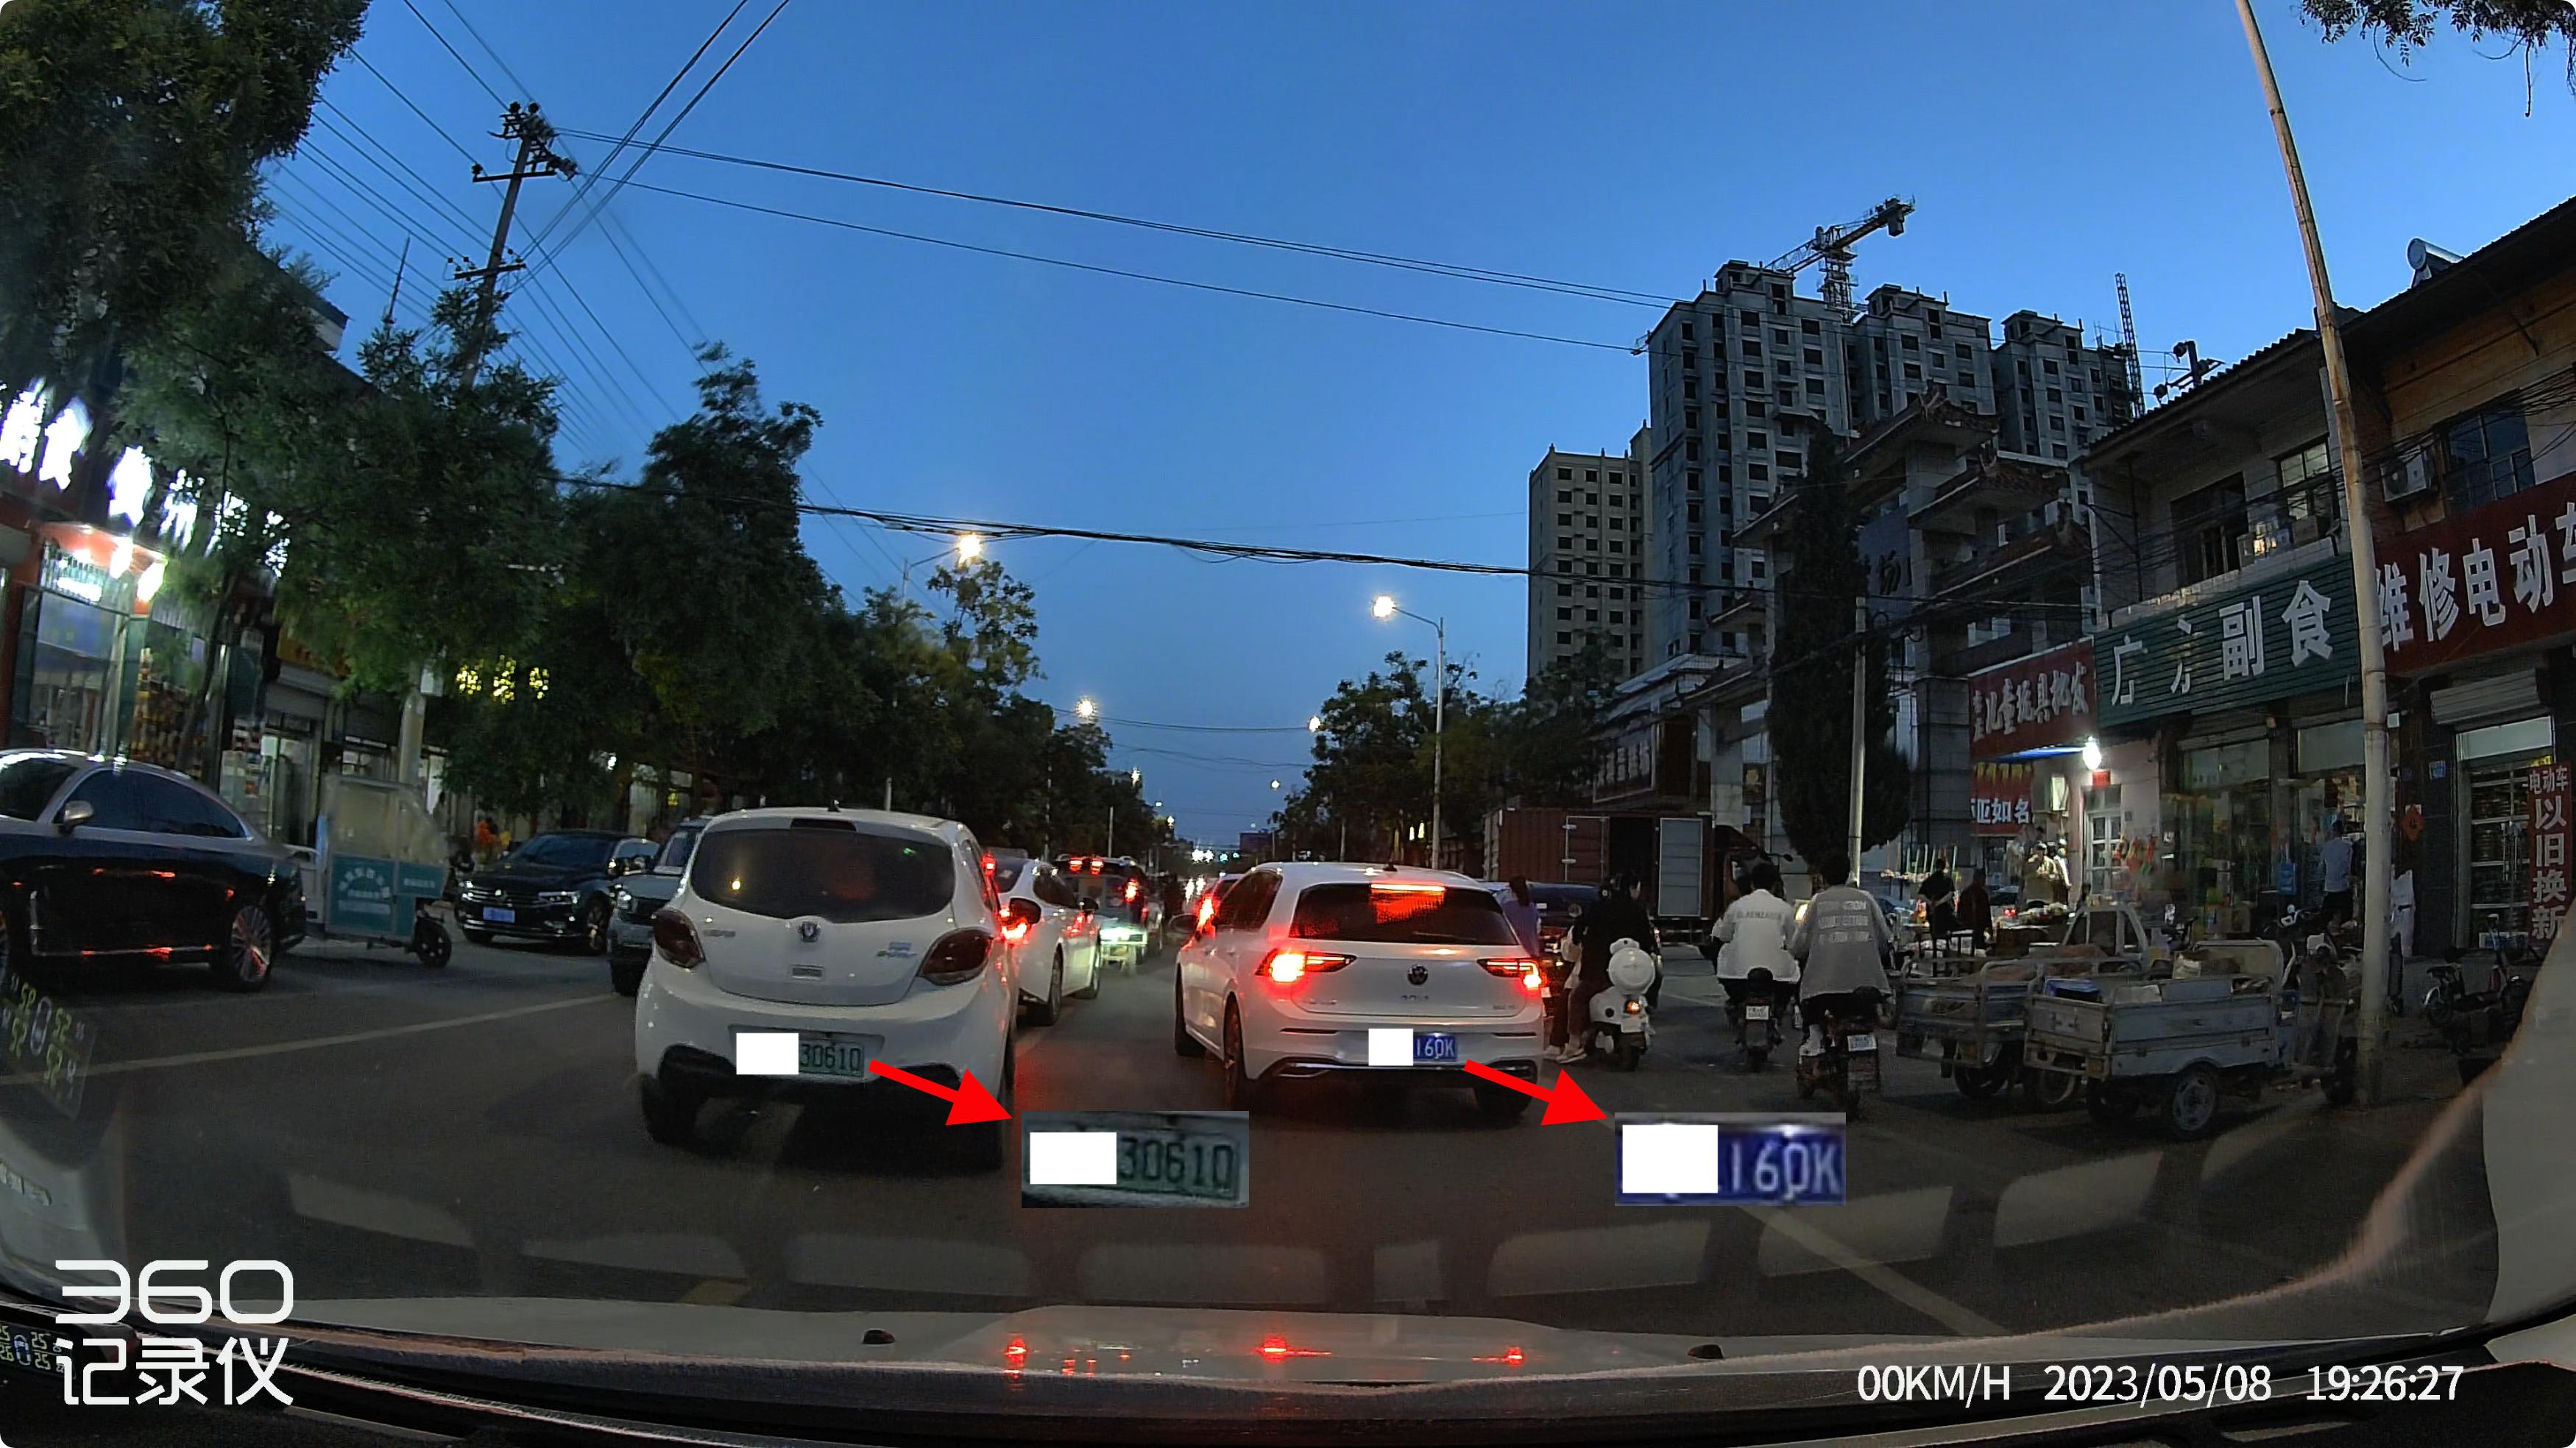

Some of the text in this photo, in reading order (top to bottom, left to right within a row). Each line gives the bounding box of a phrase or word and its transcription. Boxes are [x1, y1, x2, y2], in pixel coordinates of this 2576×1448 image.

[2529, 765, 2569, 795] 电动车
[2531, 795, 2568, 940] 以旧换新
[799, 1043, 861, 1071] 30610
